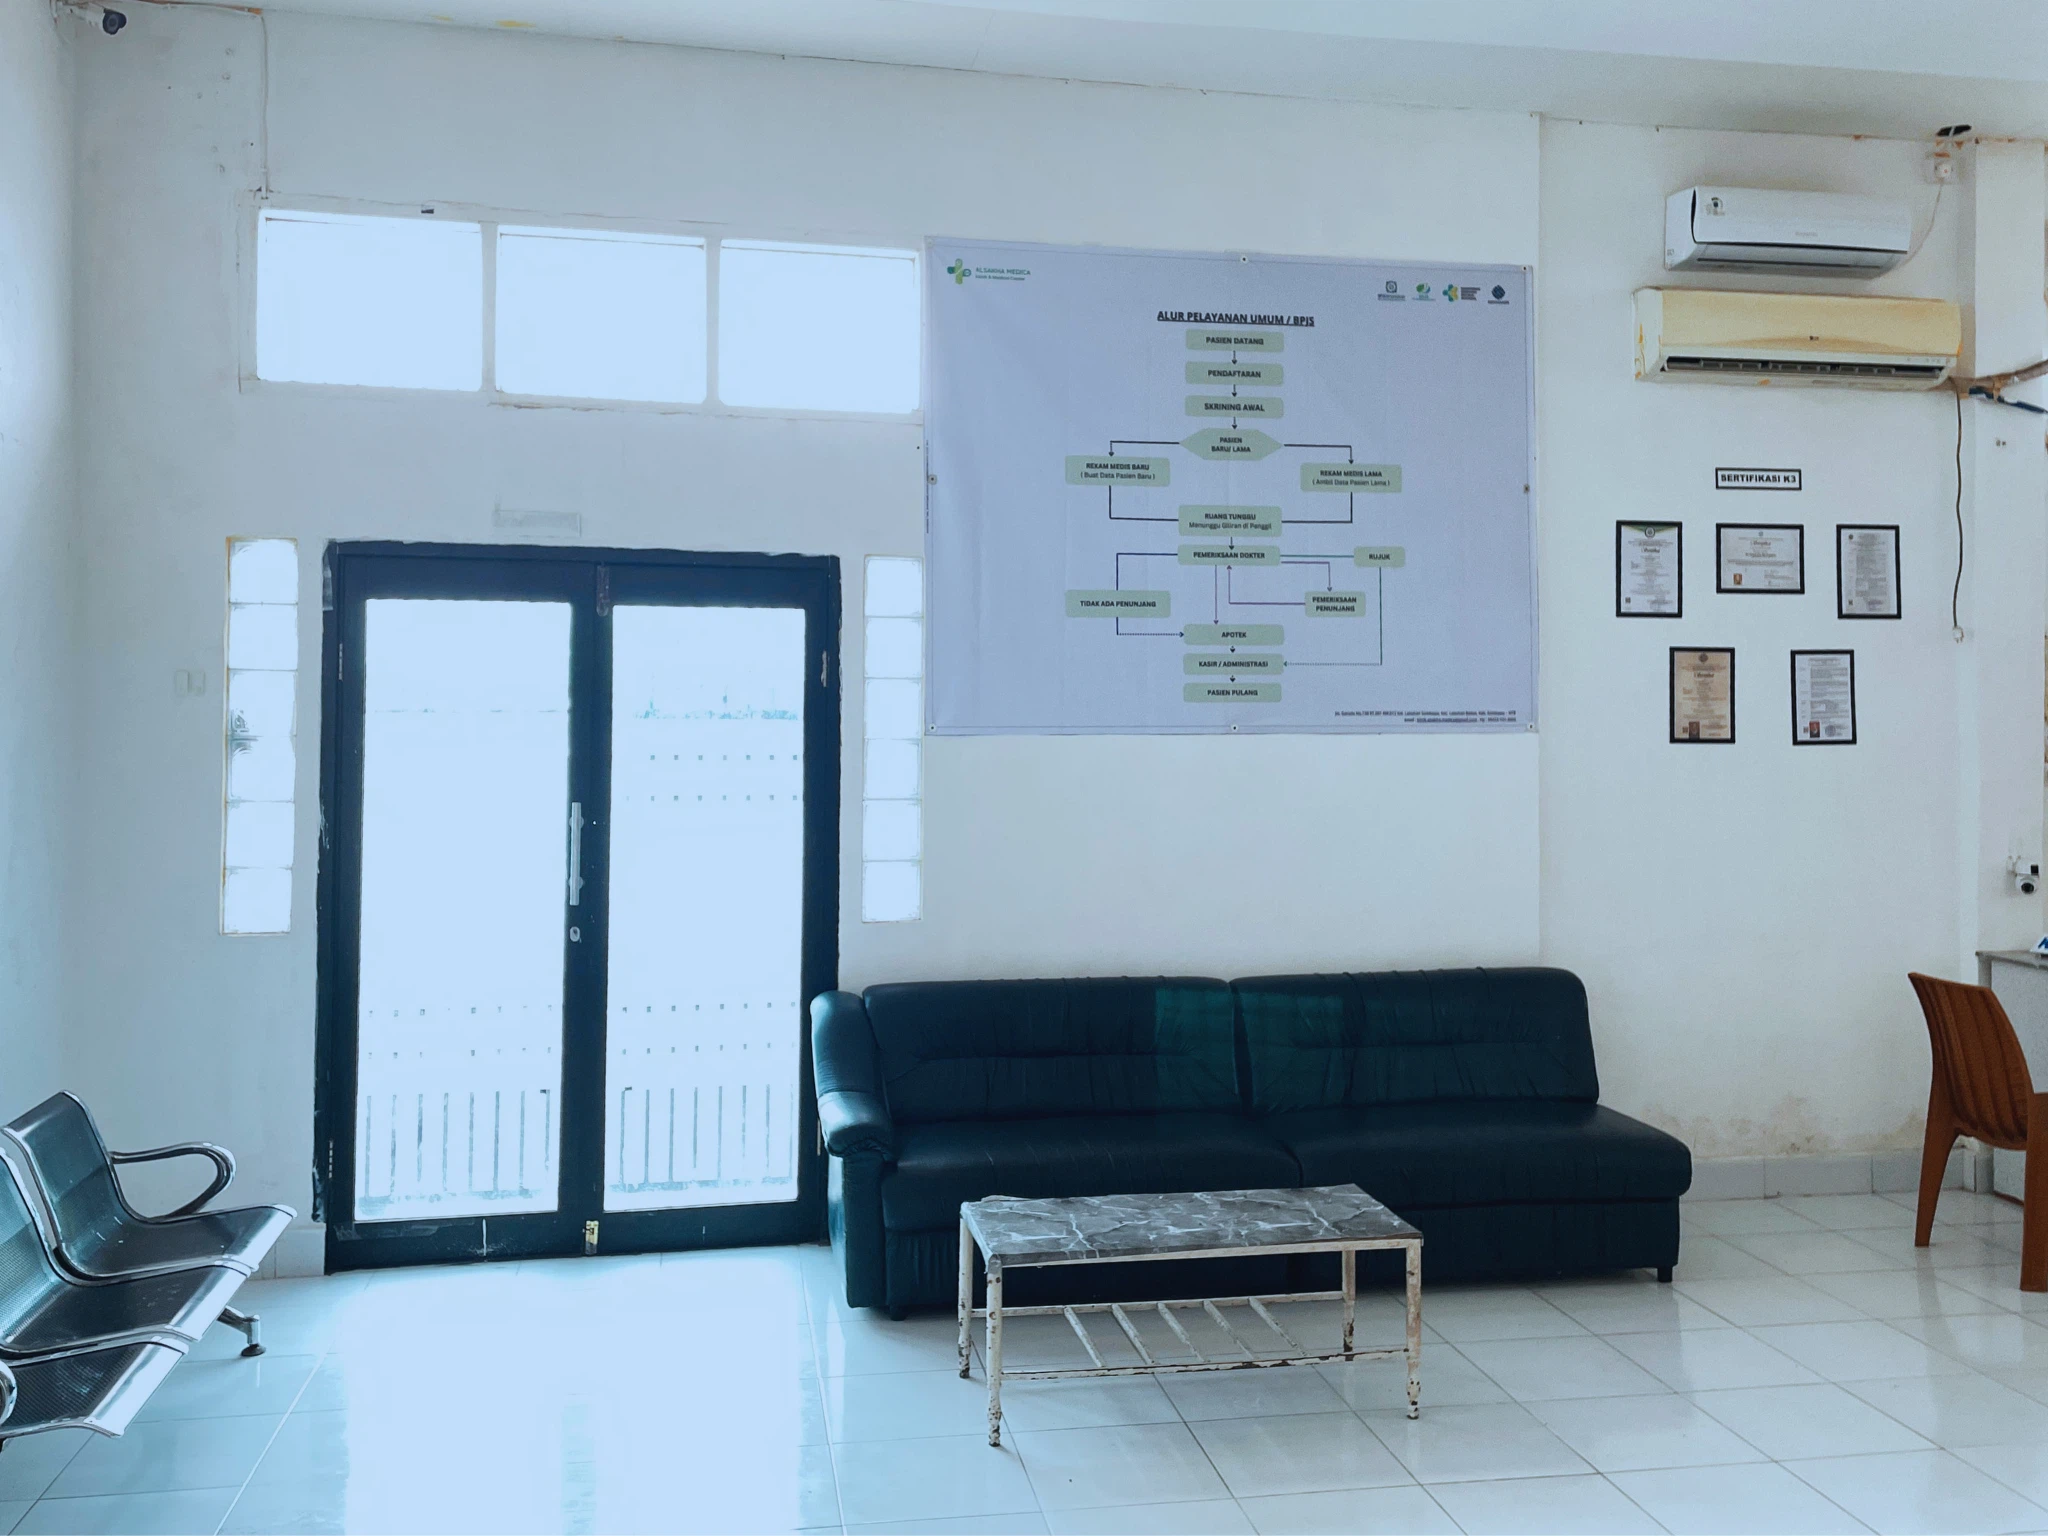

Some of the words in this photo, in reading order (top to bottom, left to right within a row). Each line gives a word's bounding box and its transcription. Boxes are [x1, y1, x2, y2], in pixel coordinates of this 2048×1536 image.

[1157, 311, 1184, 321] ALUR
[1187, 312, 1248, 324] PELAYANAN
[1250, 314, 1283, 325] UMUM
[1293, 316, 1315, 327] BPJS
[1206, 336, 1232, 344] PASIEN
[1234, 337, 1264, 345] DATANG
[1208, 370, 1261, 378] PENDAFTARAN
[1204, 403, 1241, 411] SKRINING
[1243, 403, 1265, 412] AWAL
[1721, 473, 1780, 483] SERTIFIKASI
[1783, 474, 1797, 484] K3
[1204, 513, 1228, 521] RUANG
[1189, 522, 1220, 530] Menunggu
